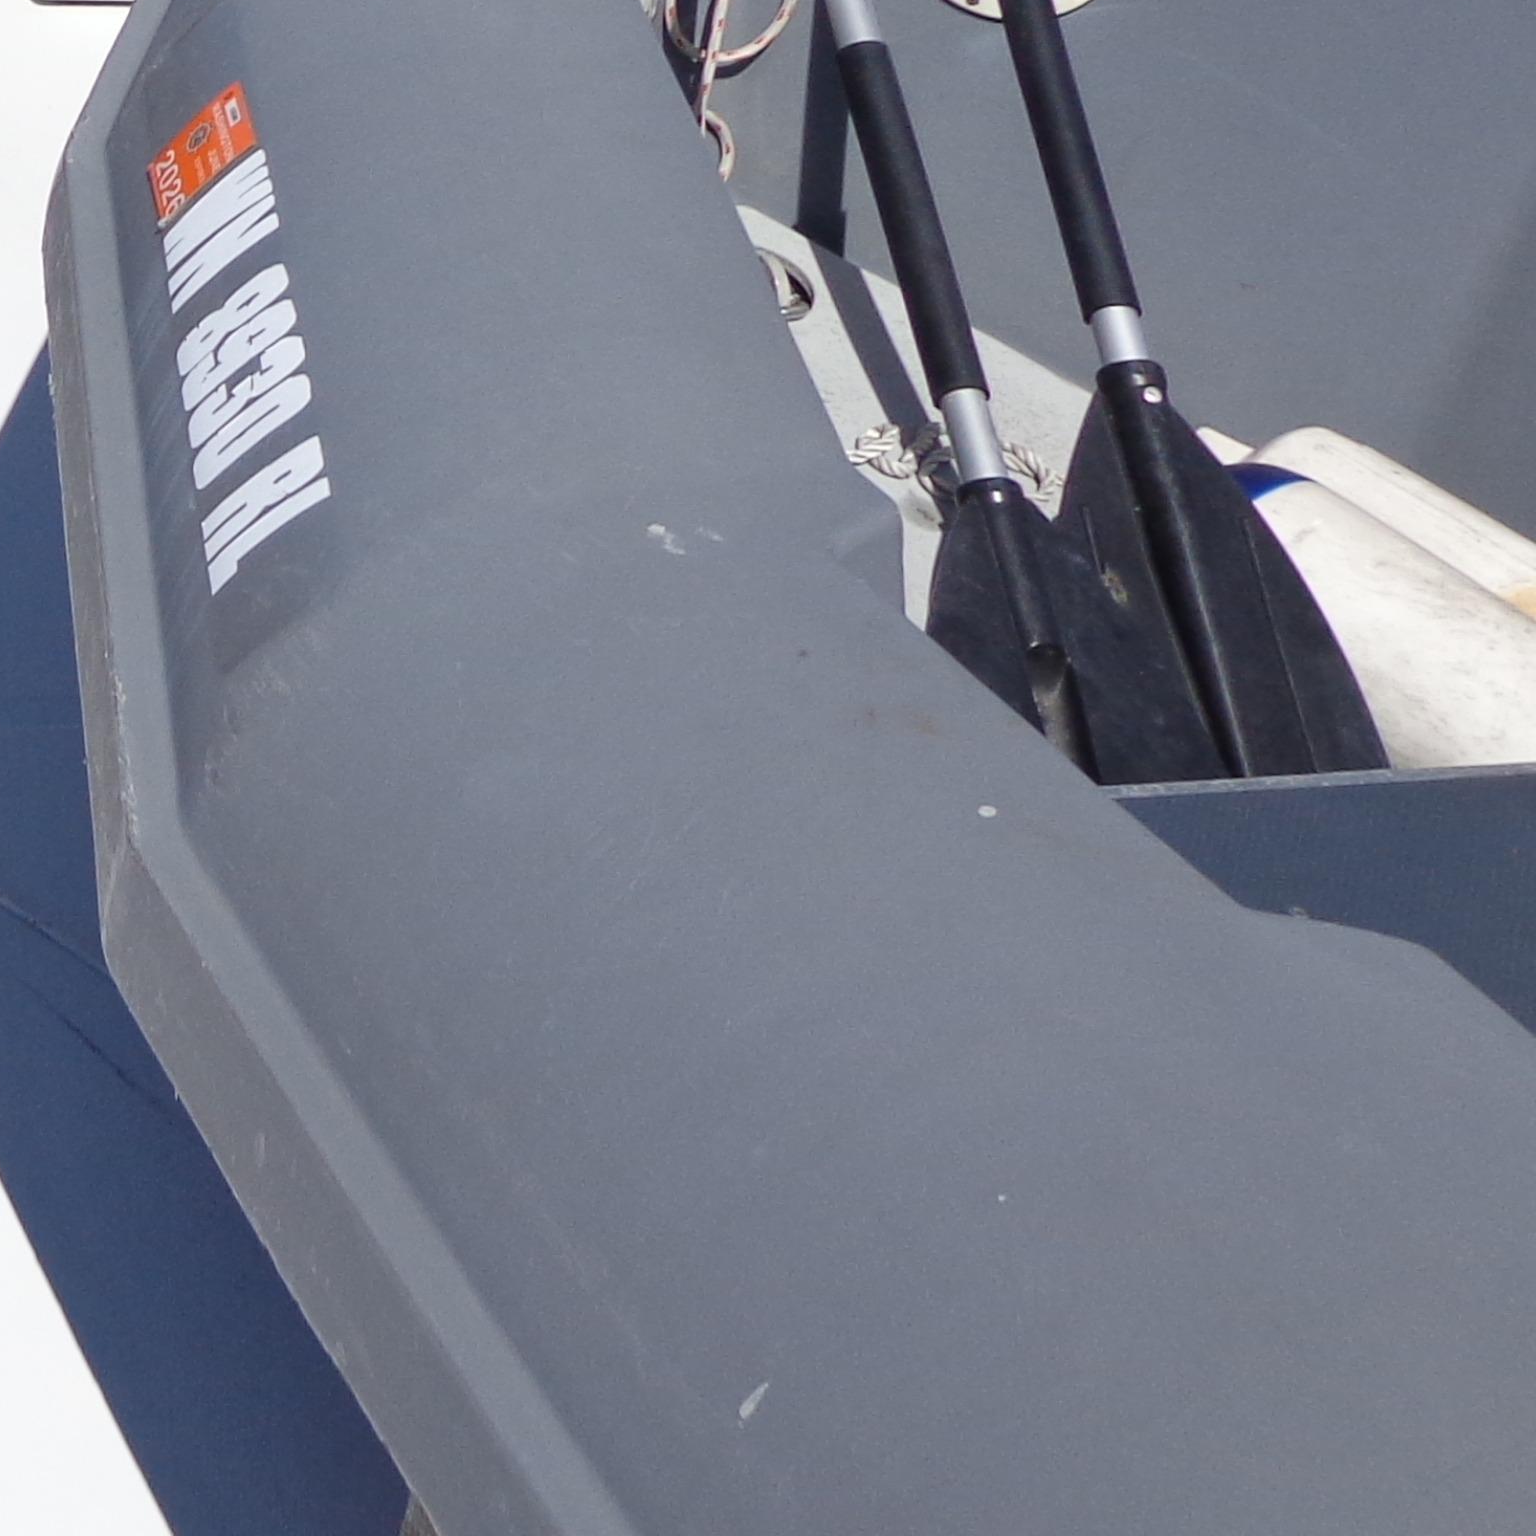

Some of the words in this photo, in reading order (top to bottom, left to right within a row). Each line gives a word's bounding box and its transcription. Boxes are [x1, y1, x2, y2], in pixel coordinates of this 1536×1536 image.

[155, 149, 186, 217] 2026
[163, 148, 279, 314] WN
[177, 263, 311, 490] 8930
[201, 435, 330, 596] RL
